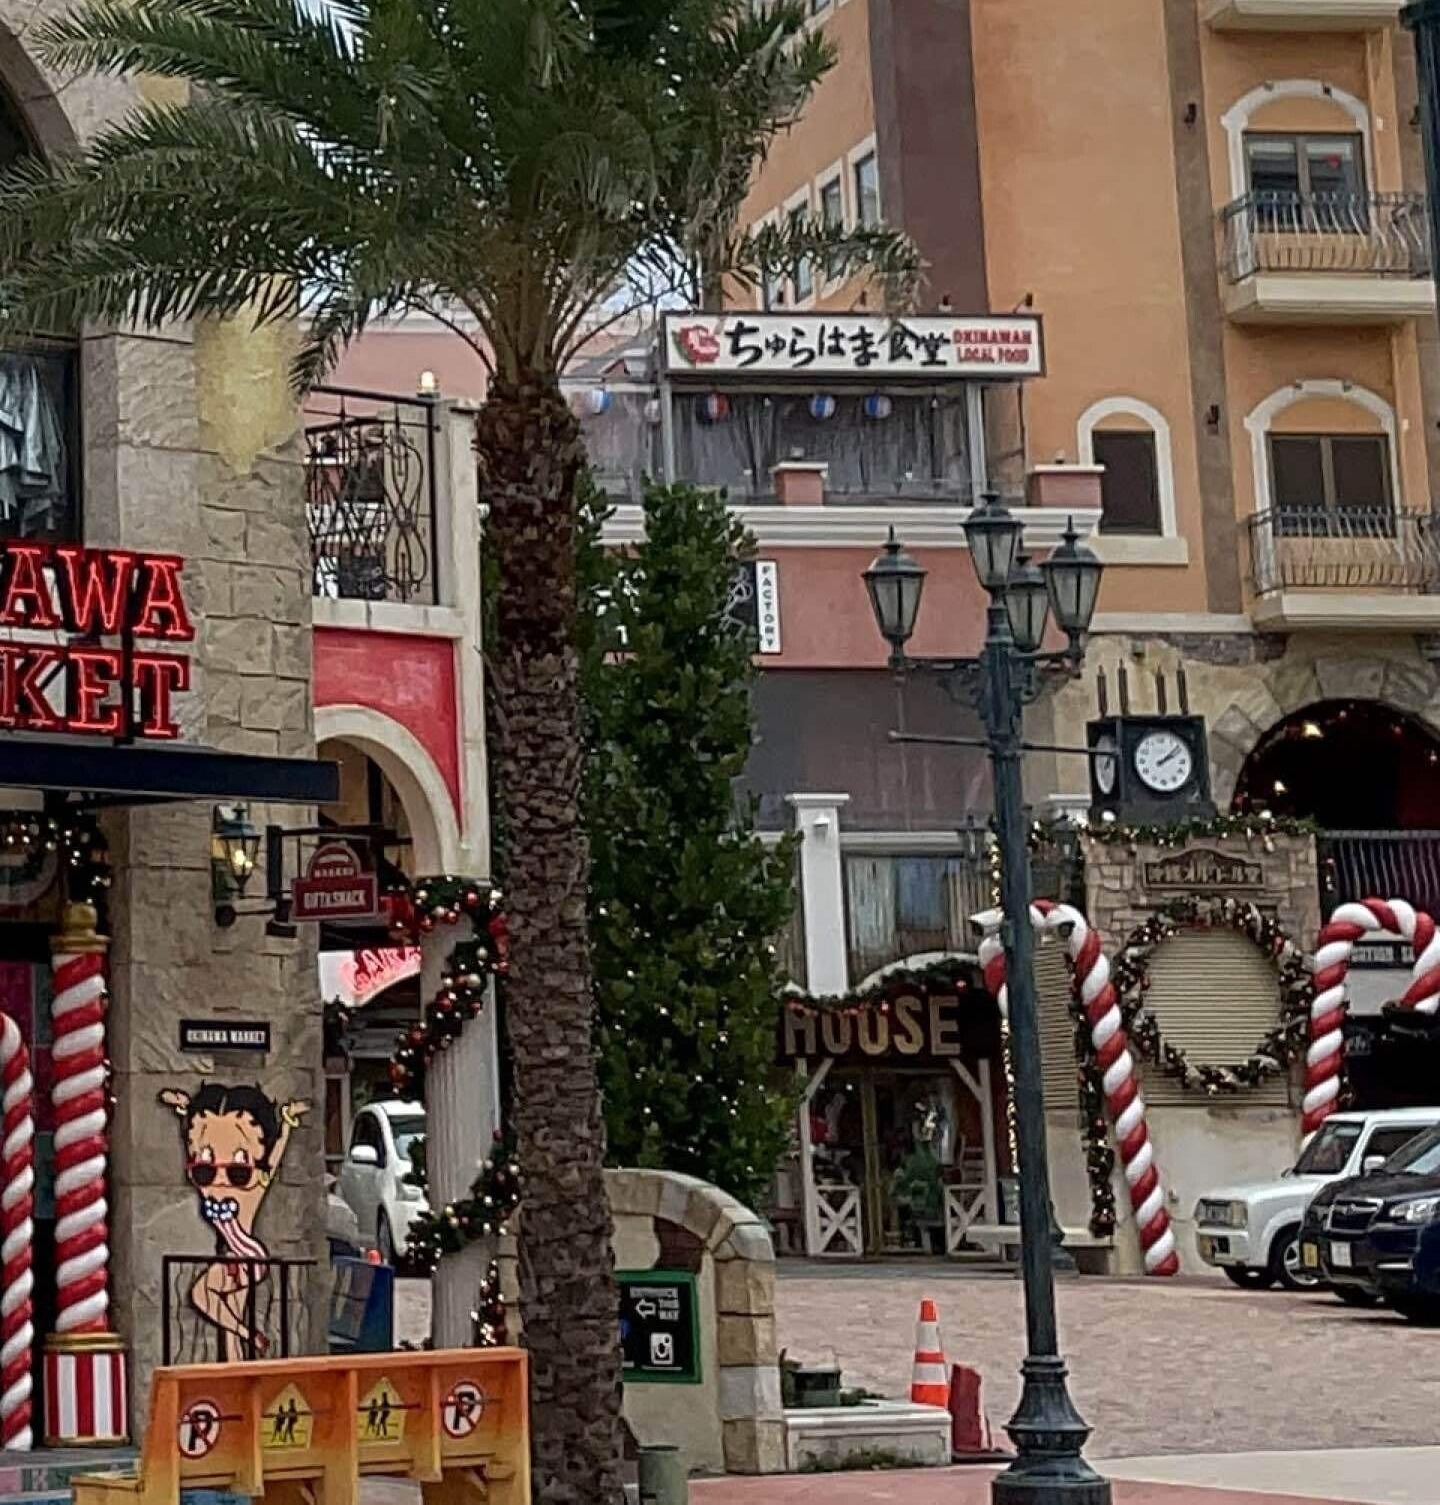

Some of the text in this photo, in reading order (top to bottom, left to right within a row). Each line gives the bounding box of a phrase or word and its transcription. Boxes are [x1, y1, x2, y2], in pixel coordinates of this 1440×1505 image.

[724, 319, 951, 368] ちゅらはま食堂
[956, 346, 1030, 364] LOCAL FOOD
[761, 565, 775, 647] FACTORY
[784, 995, 961, 1056] HOUSE
